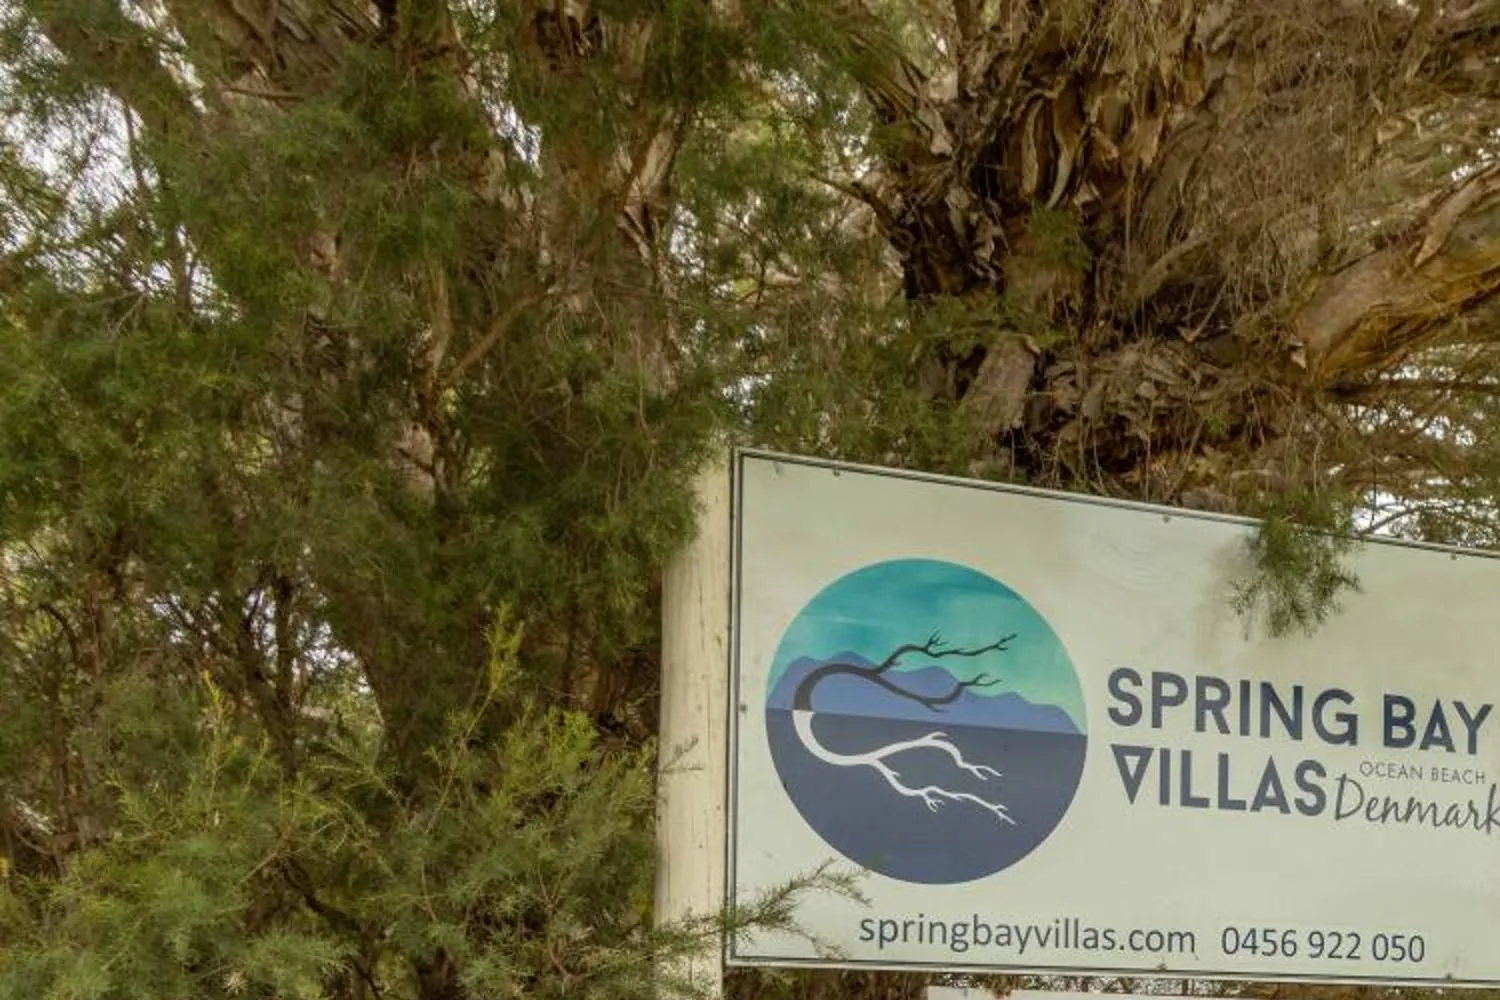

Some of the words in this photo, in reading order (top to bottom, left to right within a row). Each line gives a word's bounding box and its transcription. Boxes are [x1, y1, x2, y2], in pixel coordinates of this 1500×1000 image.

[1106, 666, 1360, 747] SPRING
[1382, 692, 1494, 756] BAY
[1110, 743, 1328, 818] VILLAS
[1358, 760, 1423, 781] OCEAN
[1431, 766, 1487, 786] BEACH
[858, 912, 1197, 956] springbayvillas.com
[1221, 926, 1299, 958] 0456
[1308, 930, 1362, 961] 922
[1371, 933, 1426, 963] 050
